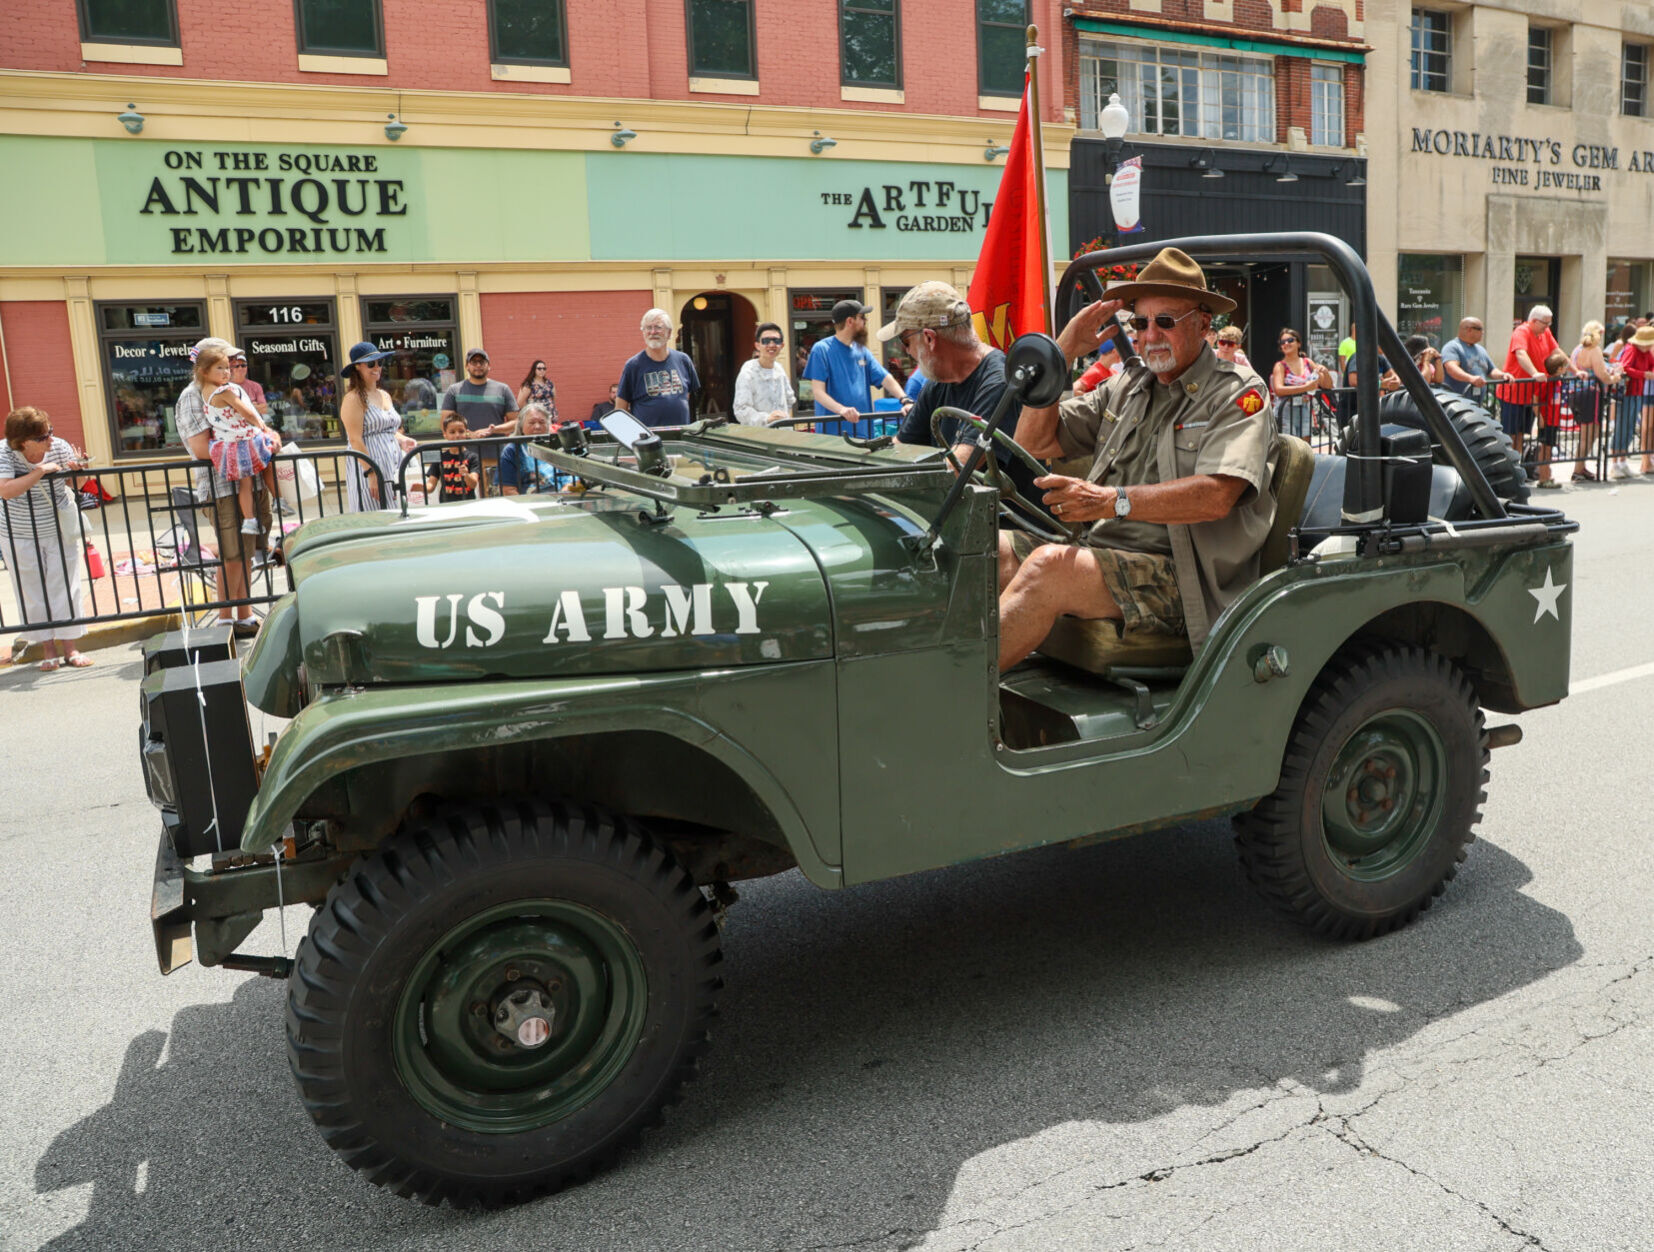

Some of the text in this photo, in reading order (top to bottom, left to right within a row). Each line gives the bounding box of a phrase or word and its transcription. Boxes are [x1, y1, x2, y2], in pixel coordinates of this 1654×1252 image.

[1411, 127, 1562, 165] MORIARTY'S
[1572, 143, 1619, 170] GEM
[164, 150, 378, 175] ON THE SQUARE
[1492, 166, 1602, 191] FINE JEWELER
[139, 176, 408, 224] ANTIQUE
[821, 192, 853, 205] THE
[896, 215, 975, 232] GARDEN
[170, 228, 388, 253] EMPORIUM
[269, 306, 303, 323] 116
[114, 343, 192, 358] Decor Jewelr
[251, 339, 325, 354] Seasonal Gifts
[378, 336, 448, 350] Art Furniture
[643, 369, 684, 397] USA
[415, 581, 770, 649] US ARMY
